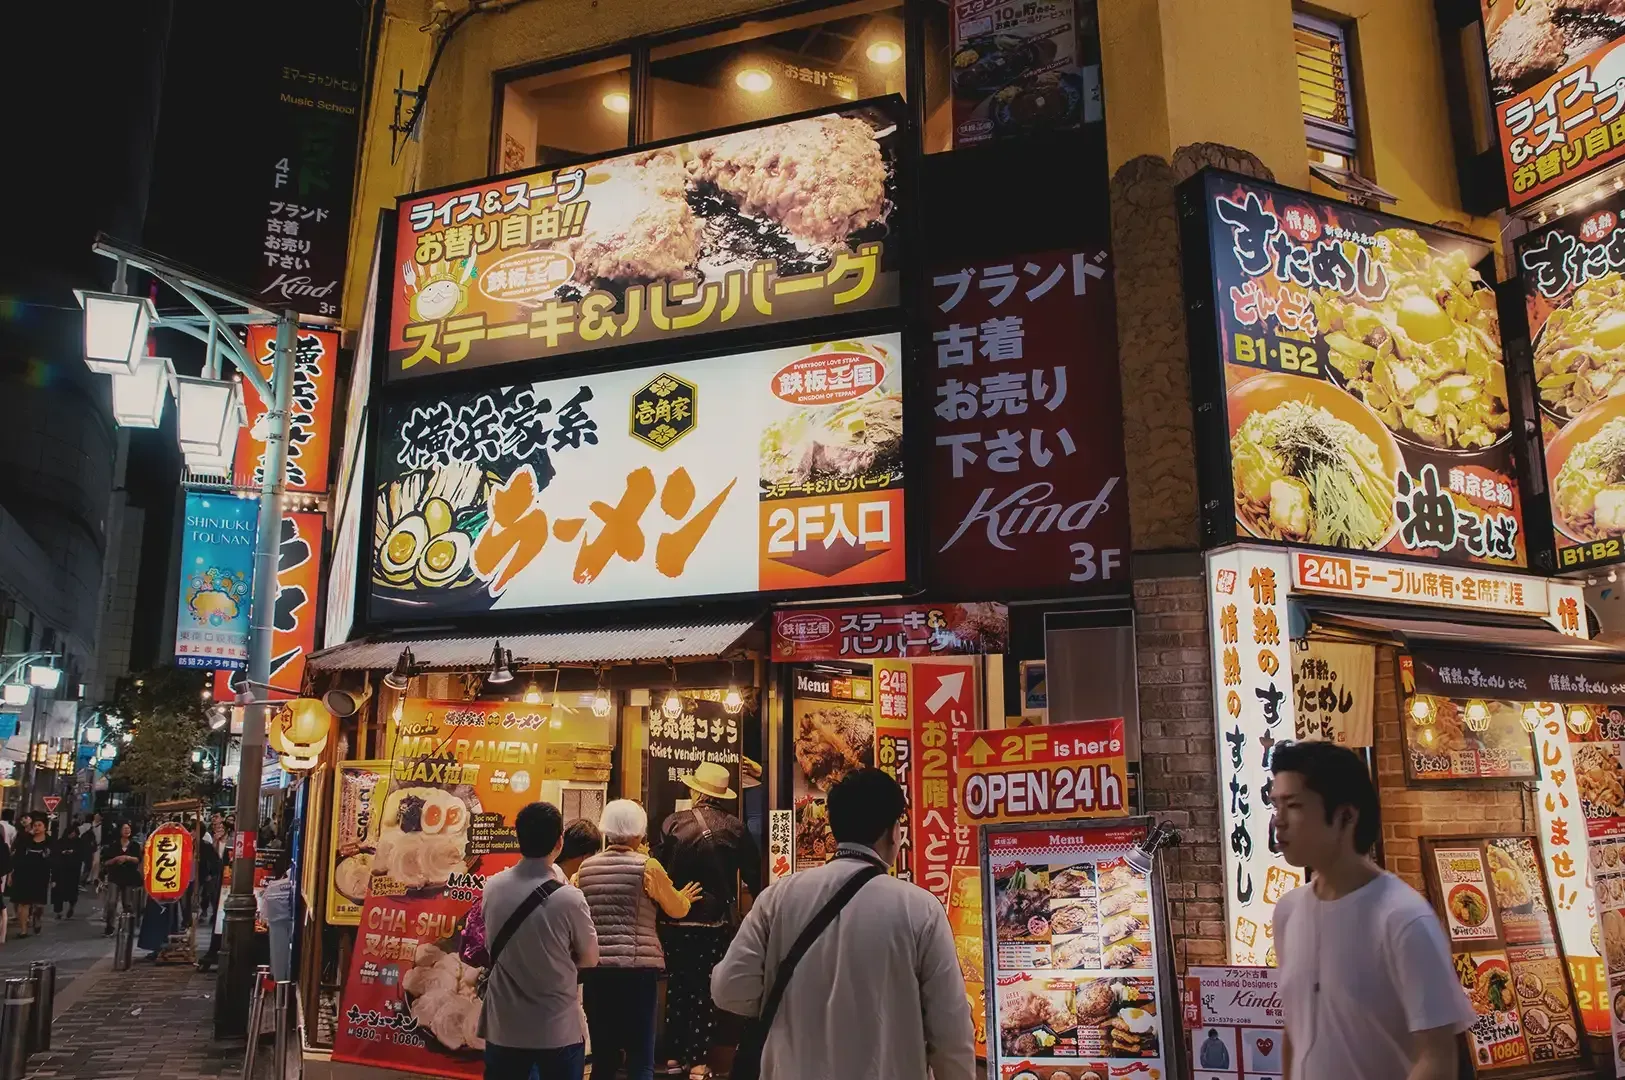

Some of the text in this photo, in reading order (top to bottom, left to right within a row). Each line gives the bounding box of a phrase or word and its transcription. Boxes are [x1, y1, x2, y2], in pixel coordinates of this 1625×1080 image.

[784, 64, 828, 87] お会計
[280, 92, 356, 115] Music School
[1504, 65, 1597, 137] ライス
[1509, 76, 1625, 165] &スープ
[274, 157, 291, 189] 4F
[268, 201, 331, 223] ブランド
[408, 171, 584, 232] ライス&スープ
[266, 218, 300, 236] 古着
[415, 200, 590, 265] お替り自由!!
[1582, 213, 1613, 239] 情熱の
[264, 235, 311, 255] お売り
[1215, 192, 1391, 301] すためし
[263, 251, 311, 271] 下さい
[260, 273, 338, 300] Kind
[933, 250, 1108, 313] ブランド
[318, 302, 337, 315] 3F
[401, 243, 883, 371] ステーキ&ハンバーグ
[933, 315, 1026, 369] 古着
[794, 360, 826, 370] EVERYBODY
[827, 358, 842, 367] LOVE
[778, 363, 877, 397] 鉄板王国
[798, 393, 826, 402] KINGDOM
[834, 390, 857, 398] TEPPAN
[933, 365, 1068, 422] お売り
[633, 396, 692, 424] 壱角家
[397, 385, 599, 467] 横浜家系
[935, 428, 1077, 479] 下さい
[765, 472, 893, 498] ステーキ&ハンバーグ
[1448, 469, 1515, 510] 東京名物
[186, 515, 256, 533] SHINJUKU
[938, 476, 1122, 553] Kind
[1392, 464, 1519, 560] 油そば
[191, 531, 251, 546] TOUNAN
[474, 464, 739, 594] ラーメン
[767, 500, 891, 554] 2F入口
[1068, 541, 1122, 582] 3F
[1303, 558, 1348, 587] 24h
[781, 620, 831, 637] 鉄板王国
[840, 609, 949, 634] ステーキ&
[1300, 658, 1338, 682] 情熱の
[1438, 666, 1505, 690] 情熱のすためし
[797, 675, 831, 694] Menu
[880, 694, 908, 718] 営業
[502, 711, 548, 730] ラーメン
[399, 735, 539, 765] MAX RAMEN
[1001, 732, 1121, 763] 2F is here
[493, 769, 507, 778] Soy
[966, 766, 1120, 816] OPEN 24h
[485, 814, 499, 822] nori
[476, 828, 489, 836] soft
[489, 827, 510, 836] boiled
[1048, 834, 1084, 846] Menu
[155, 836, 178, 890] もんじゃ
[447, 872, 486, 891] MAX
[360, 968, 379, 978] sauce
[364, 960, 378, 971] Soy
[381, 967, 399, 978] Salt
[1225, 969, 1268, 979] ブランド古着
[1221, 979, 1240, 988] Hand
[1241, 980, 1278, 990] Designers
[1204, 994, 1216, 1004] 3F
[346, 1003, 420, 1032] チャーシューメン
